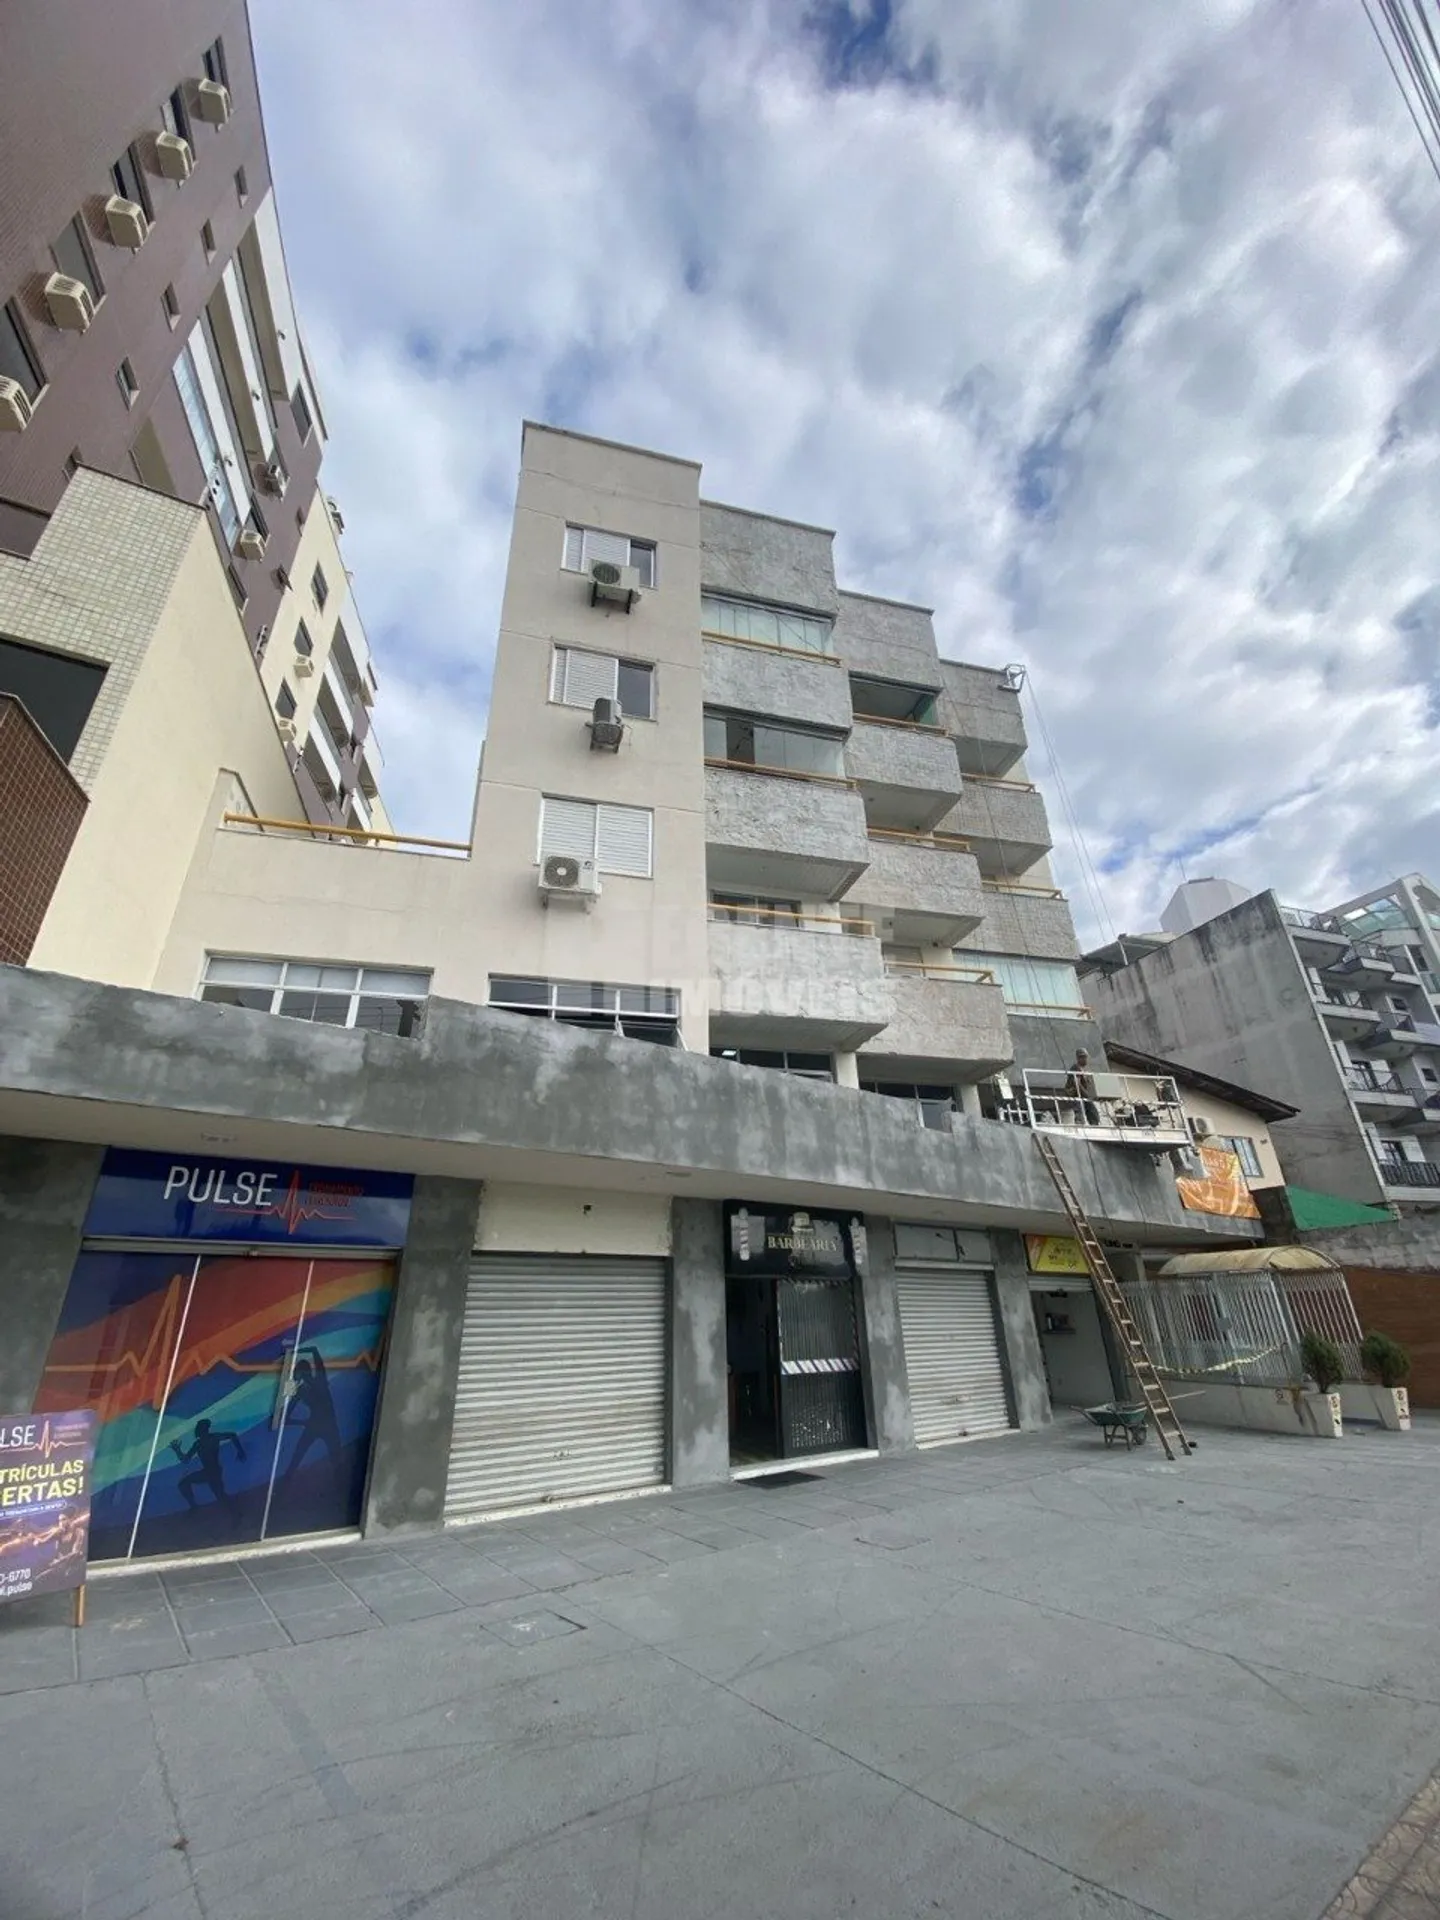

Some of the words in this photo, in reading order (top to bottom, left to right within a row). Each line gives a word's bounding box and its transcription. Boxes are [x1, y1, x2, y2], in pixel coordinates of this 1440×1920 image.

[164, 1166, 278, 1207] PULSE
[767, 1235, 837, 1252] BARBEARIA
[2, 1476, 84, 1507] ERTAS!
